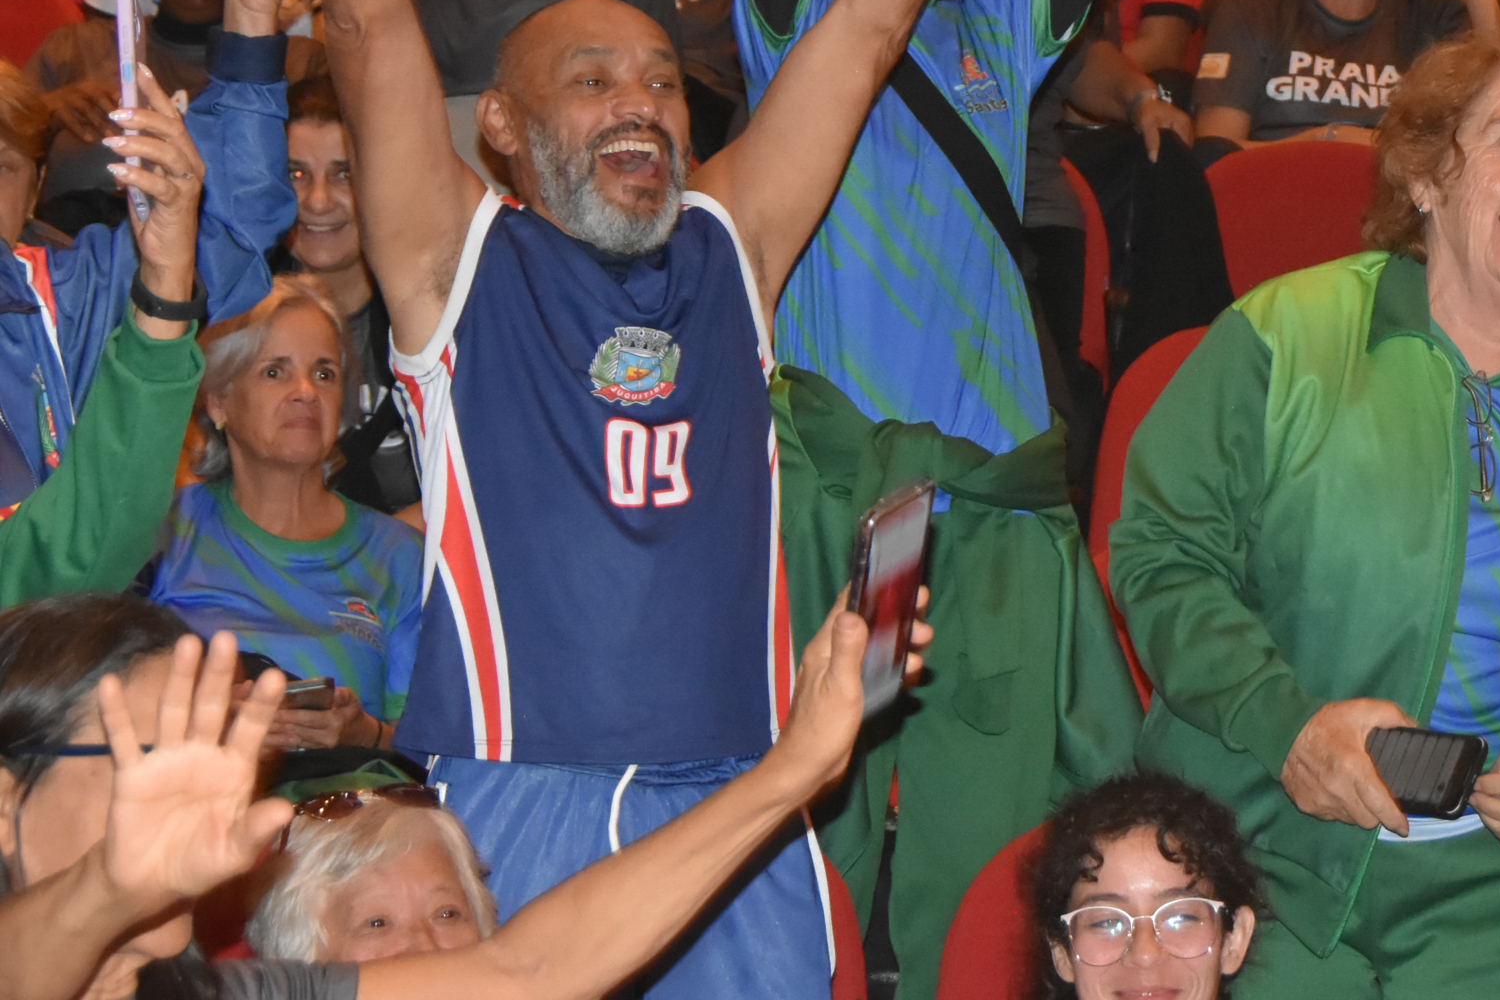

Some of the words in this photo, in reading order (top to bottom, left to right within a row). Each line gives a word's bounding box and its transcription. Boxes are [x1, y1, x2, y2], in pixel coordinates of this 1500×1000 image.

[1265, 75, 1392, 109] GRAN
[609, 381, 667, 401] JUQUITIBA
[603, 416, 693, 509] 09
